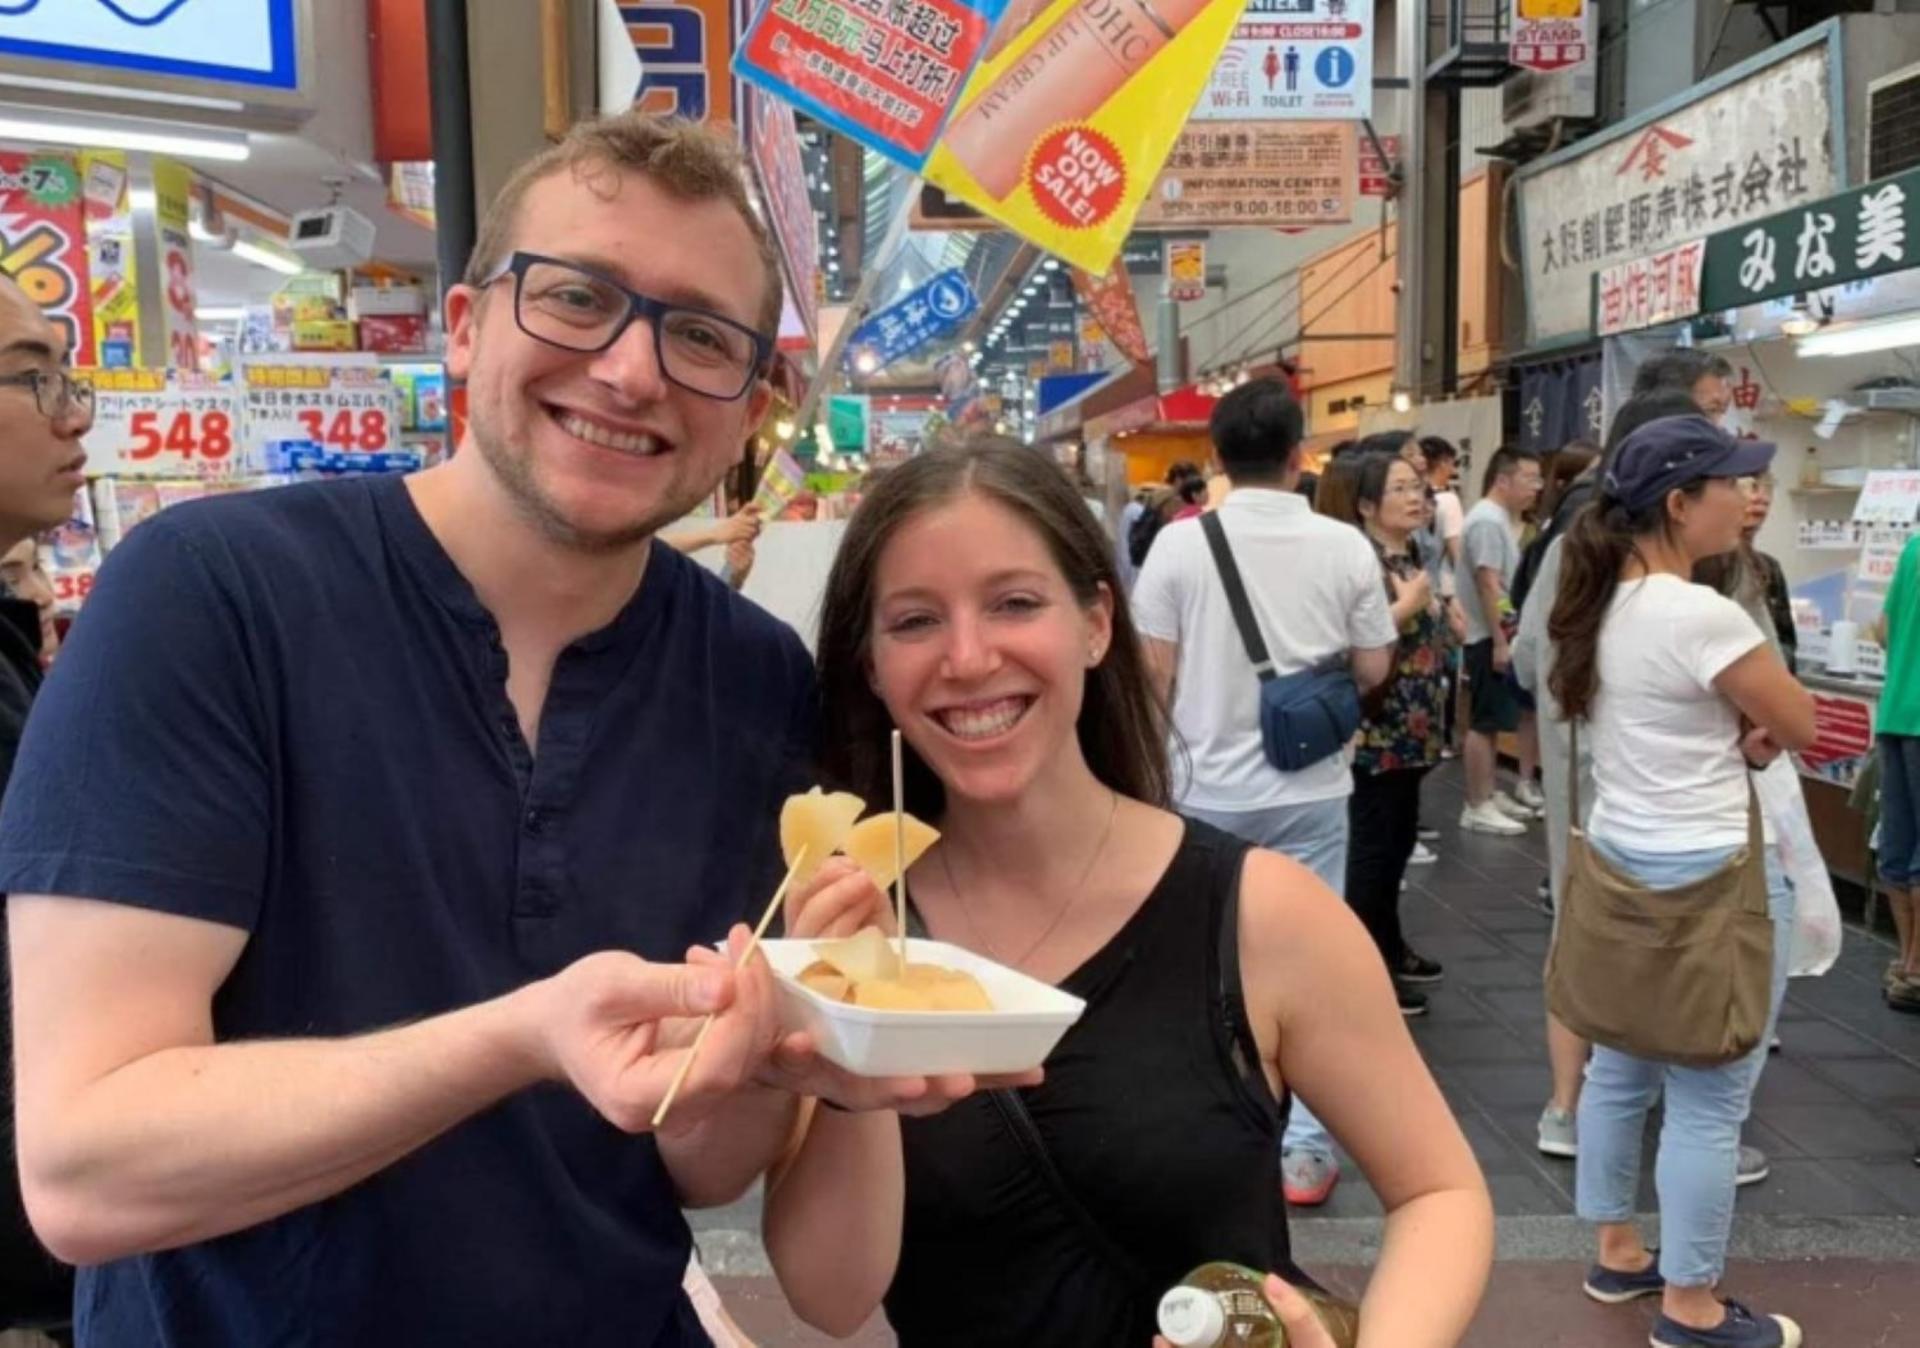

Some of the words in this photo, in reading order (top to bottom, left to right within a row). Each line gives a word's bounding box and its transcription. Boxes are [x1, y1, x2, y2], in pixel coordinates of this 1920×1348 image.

[1083, 0, 1149, 62] DHC
[1516, 29, 1581, 42] STAMP
[977, 52, 1046, 120] CREAM
[1262, 96, 1304, 107] TOILET
[1057, 155, 1099, 197] ON
[1062, 130, 1120, 187] NOW
[1184, 177, 1280, 188] INFORMATION
[1284, 177, 1341, 188] CENTER
[1034, 163, 1098, 224] SALE!
[1740, 184, 1906, 292] みな美
[130, 411, 231, 460] 548
[298, 409, 386, 452] 348
